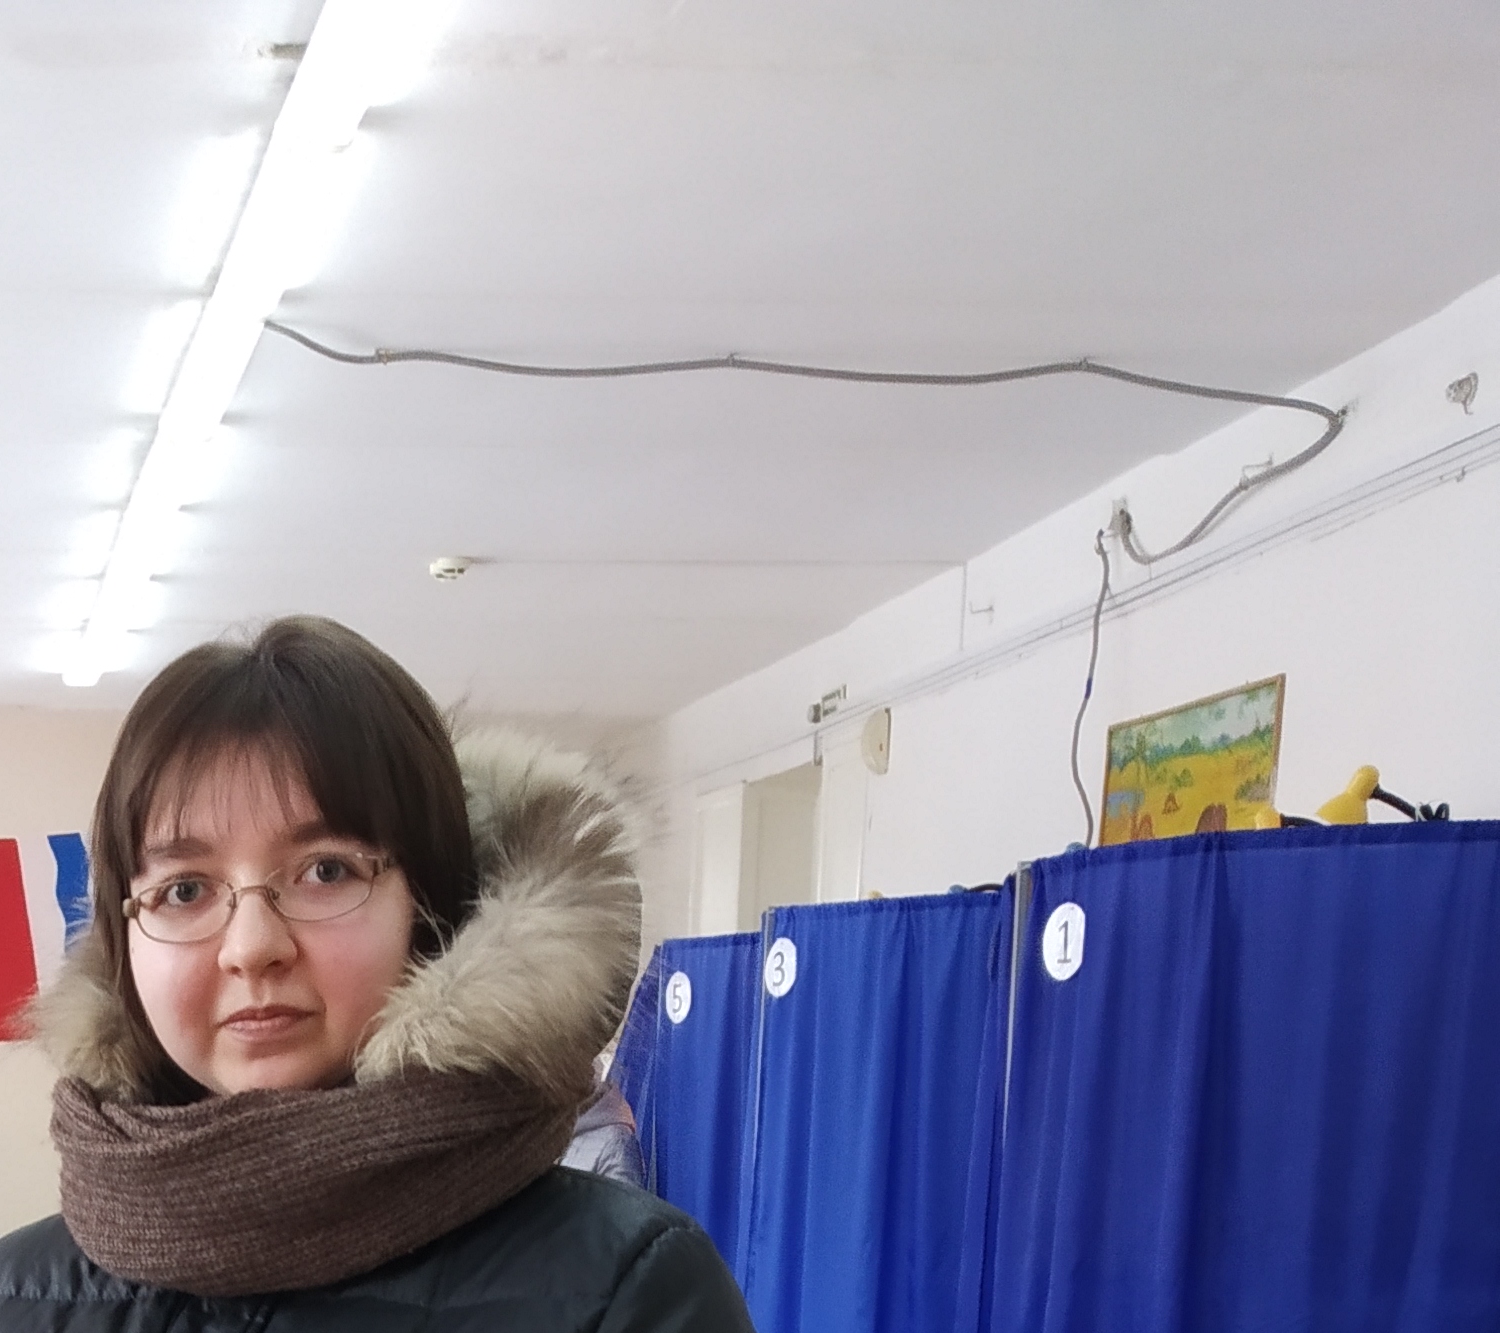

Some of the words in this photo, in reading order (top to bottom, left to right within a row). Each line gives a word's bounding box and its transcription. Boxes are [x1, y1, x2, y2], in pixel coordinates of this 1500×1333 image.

[1057, 920, 1072, 964] 1
[773, 952, 786, 986] 3
[672, 983, 683, 1014] 5
